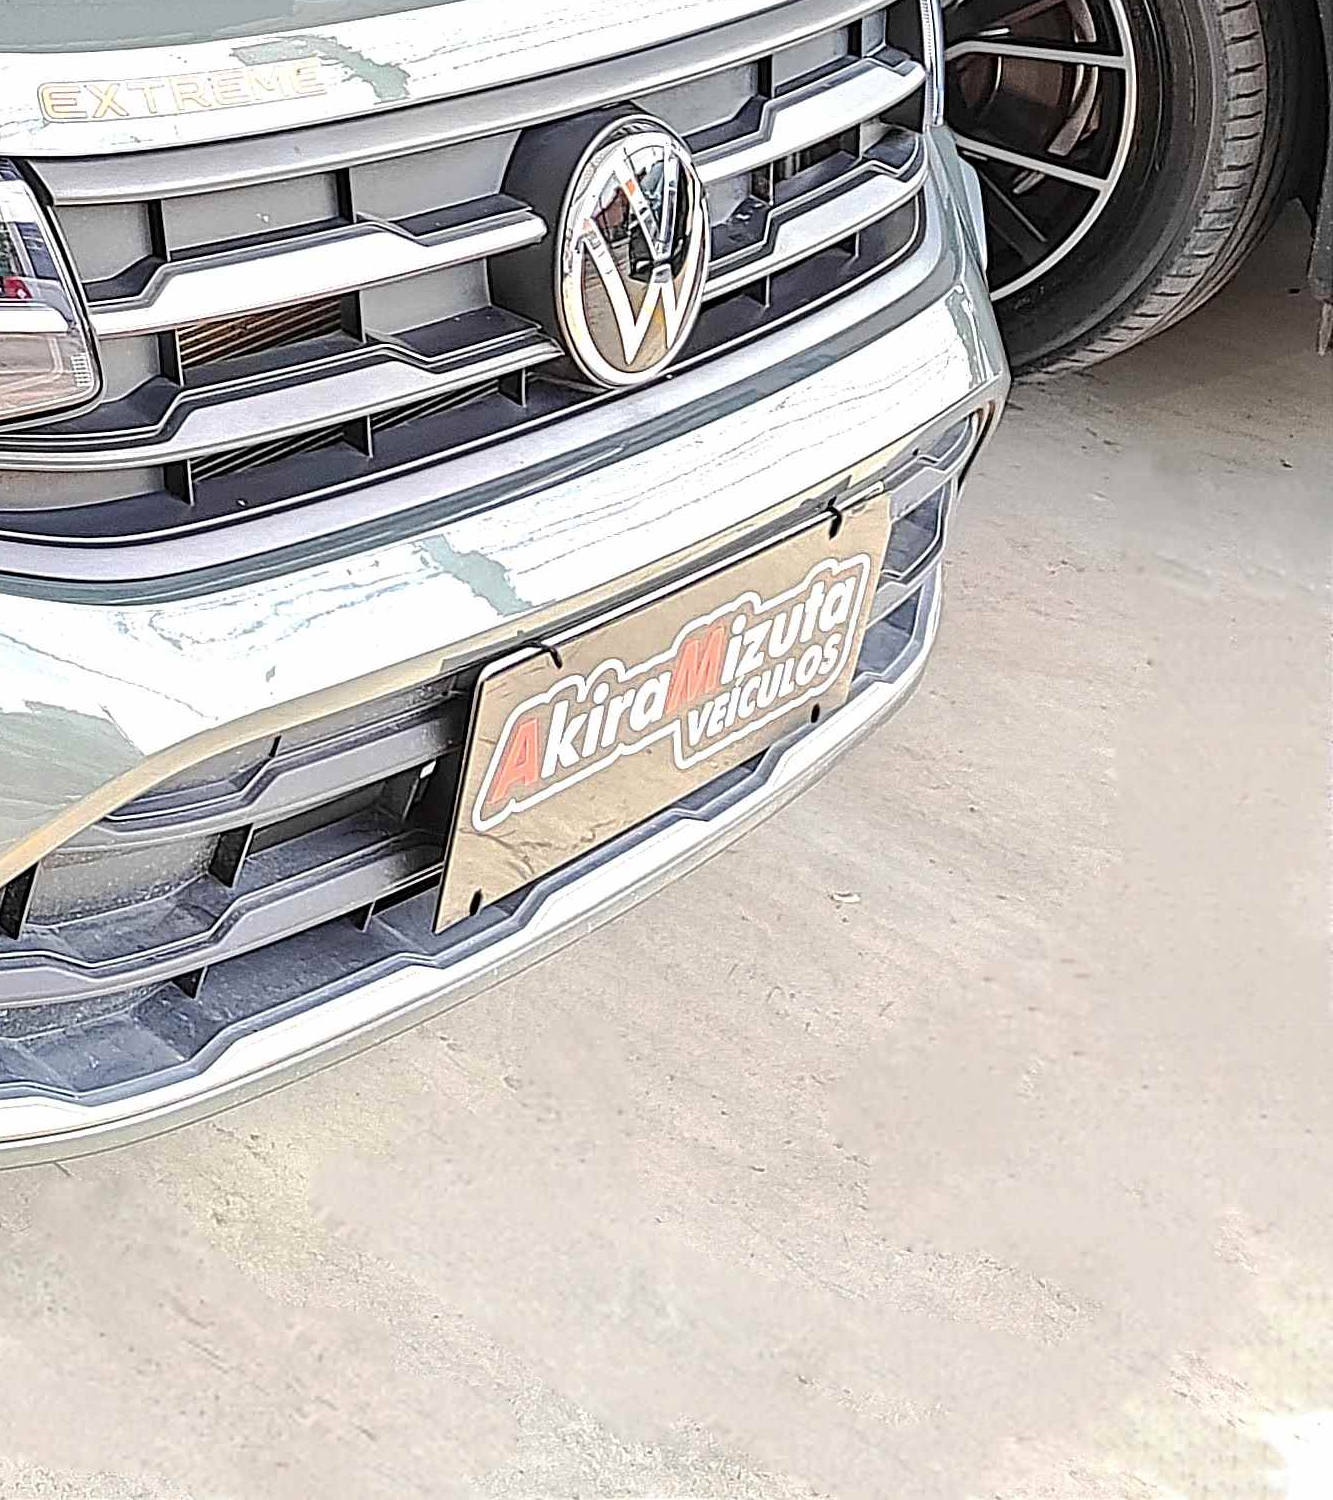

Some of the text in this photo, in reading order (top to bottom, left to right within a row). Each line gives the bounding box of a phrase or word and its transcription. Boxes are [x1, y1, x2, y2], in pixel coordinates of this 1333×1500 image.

[41, 55, 326, 120] EXTREME
[488, 576, 853, 806] AkiraMizuta
[686, 634, 842, 747] VEÍCULOS
